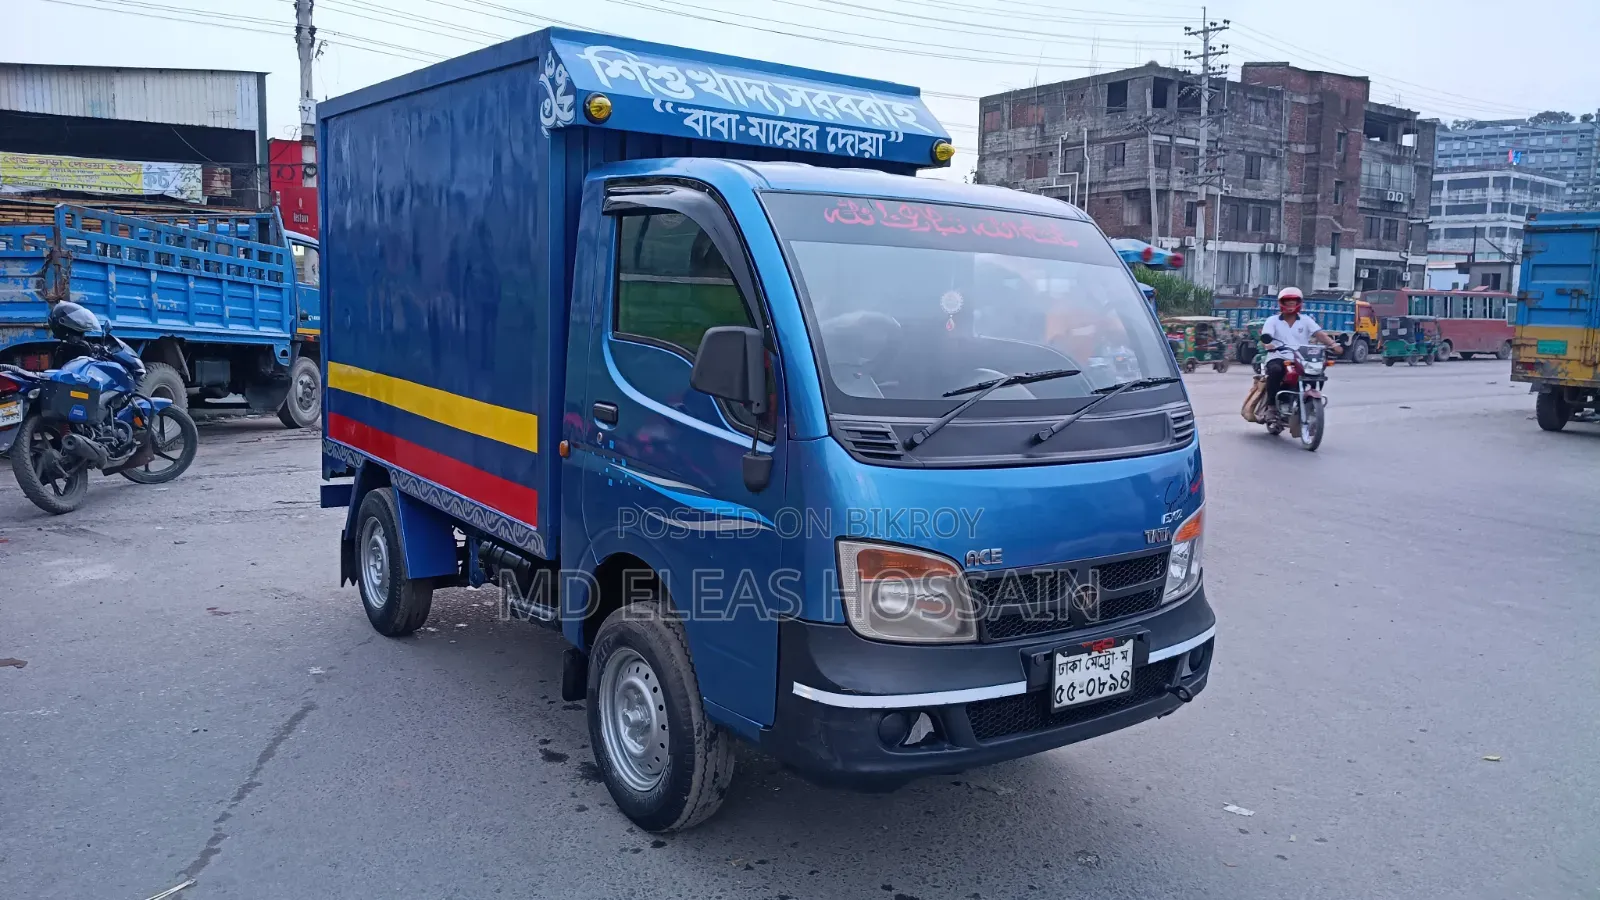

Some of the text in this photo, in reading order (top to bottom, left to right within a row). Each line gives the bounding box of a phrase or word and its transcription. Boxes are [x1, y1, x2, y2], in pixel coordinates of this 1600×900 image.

[1144, 526, 1172, 544] TATA
[965, 547, 1003, 568] ACE
[1058, 658, 1082, 676] ঢাকা
